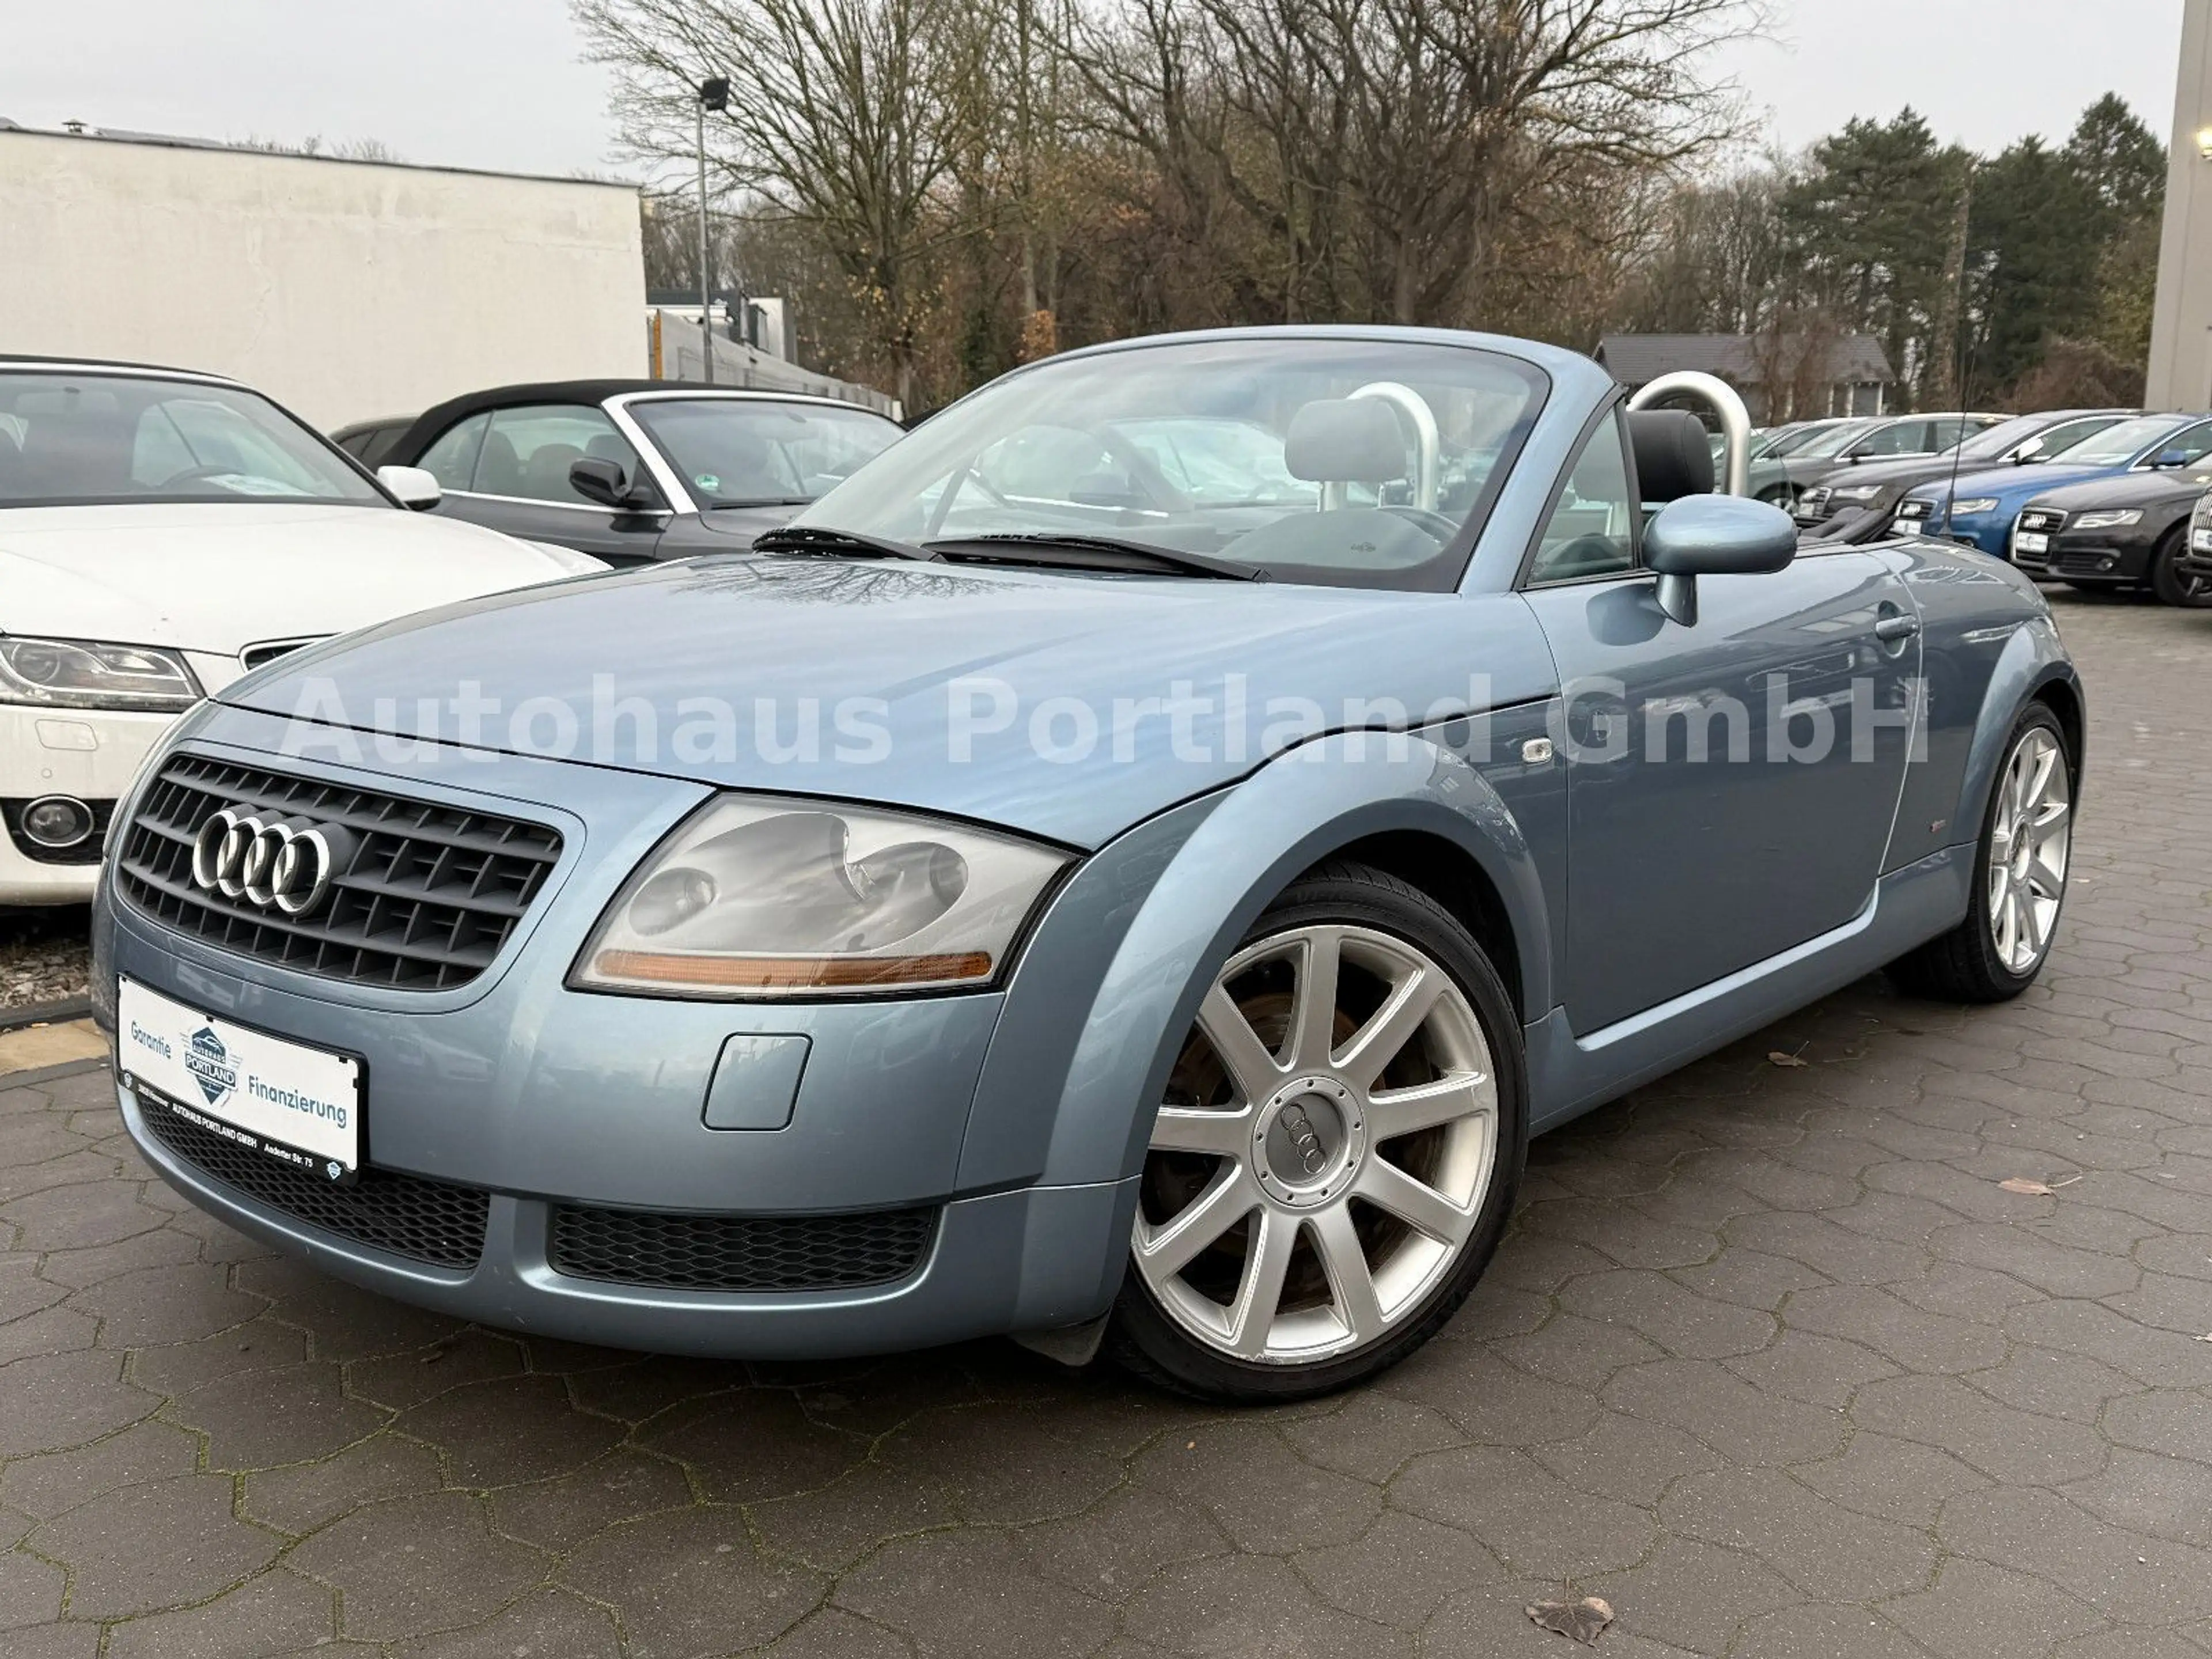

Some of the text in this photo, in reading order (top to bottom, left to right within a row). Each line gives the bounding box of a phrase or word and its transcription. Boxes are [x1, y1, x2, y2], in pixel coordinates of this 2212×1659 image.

[131, 1020, 172, 1059] Garantie
[186, 1056, 235, 1084] PORTLAND
[249, 1075, 347, 1129] Finanzierung
[202, 1116, 236, 1141] PORTLAND
